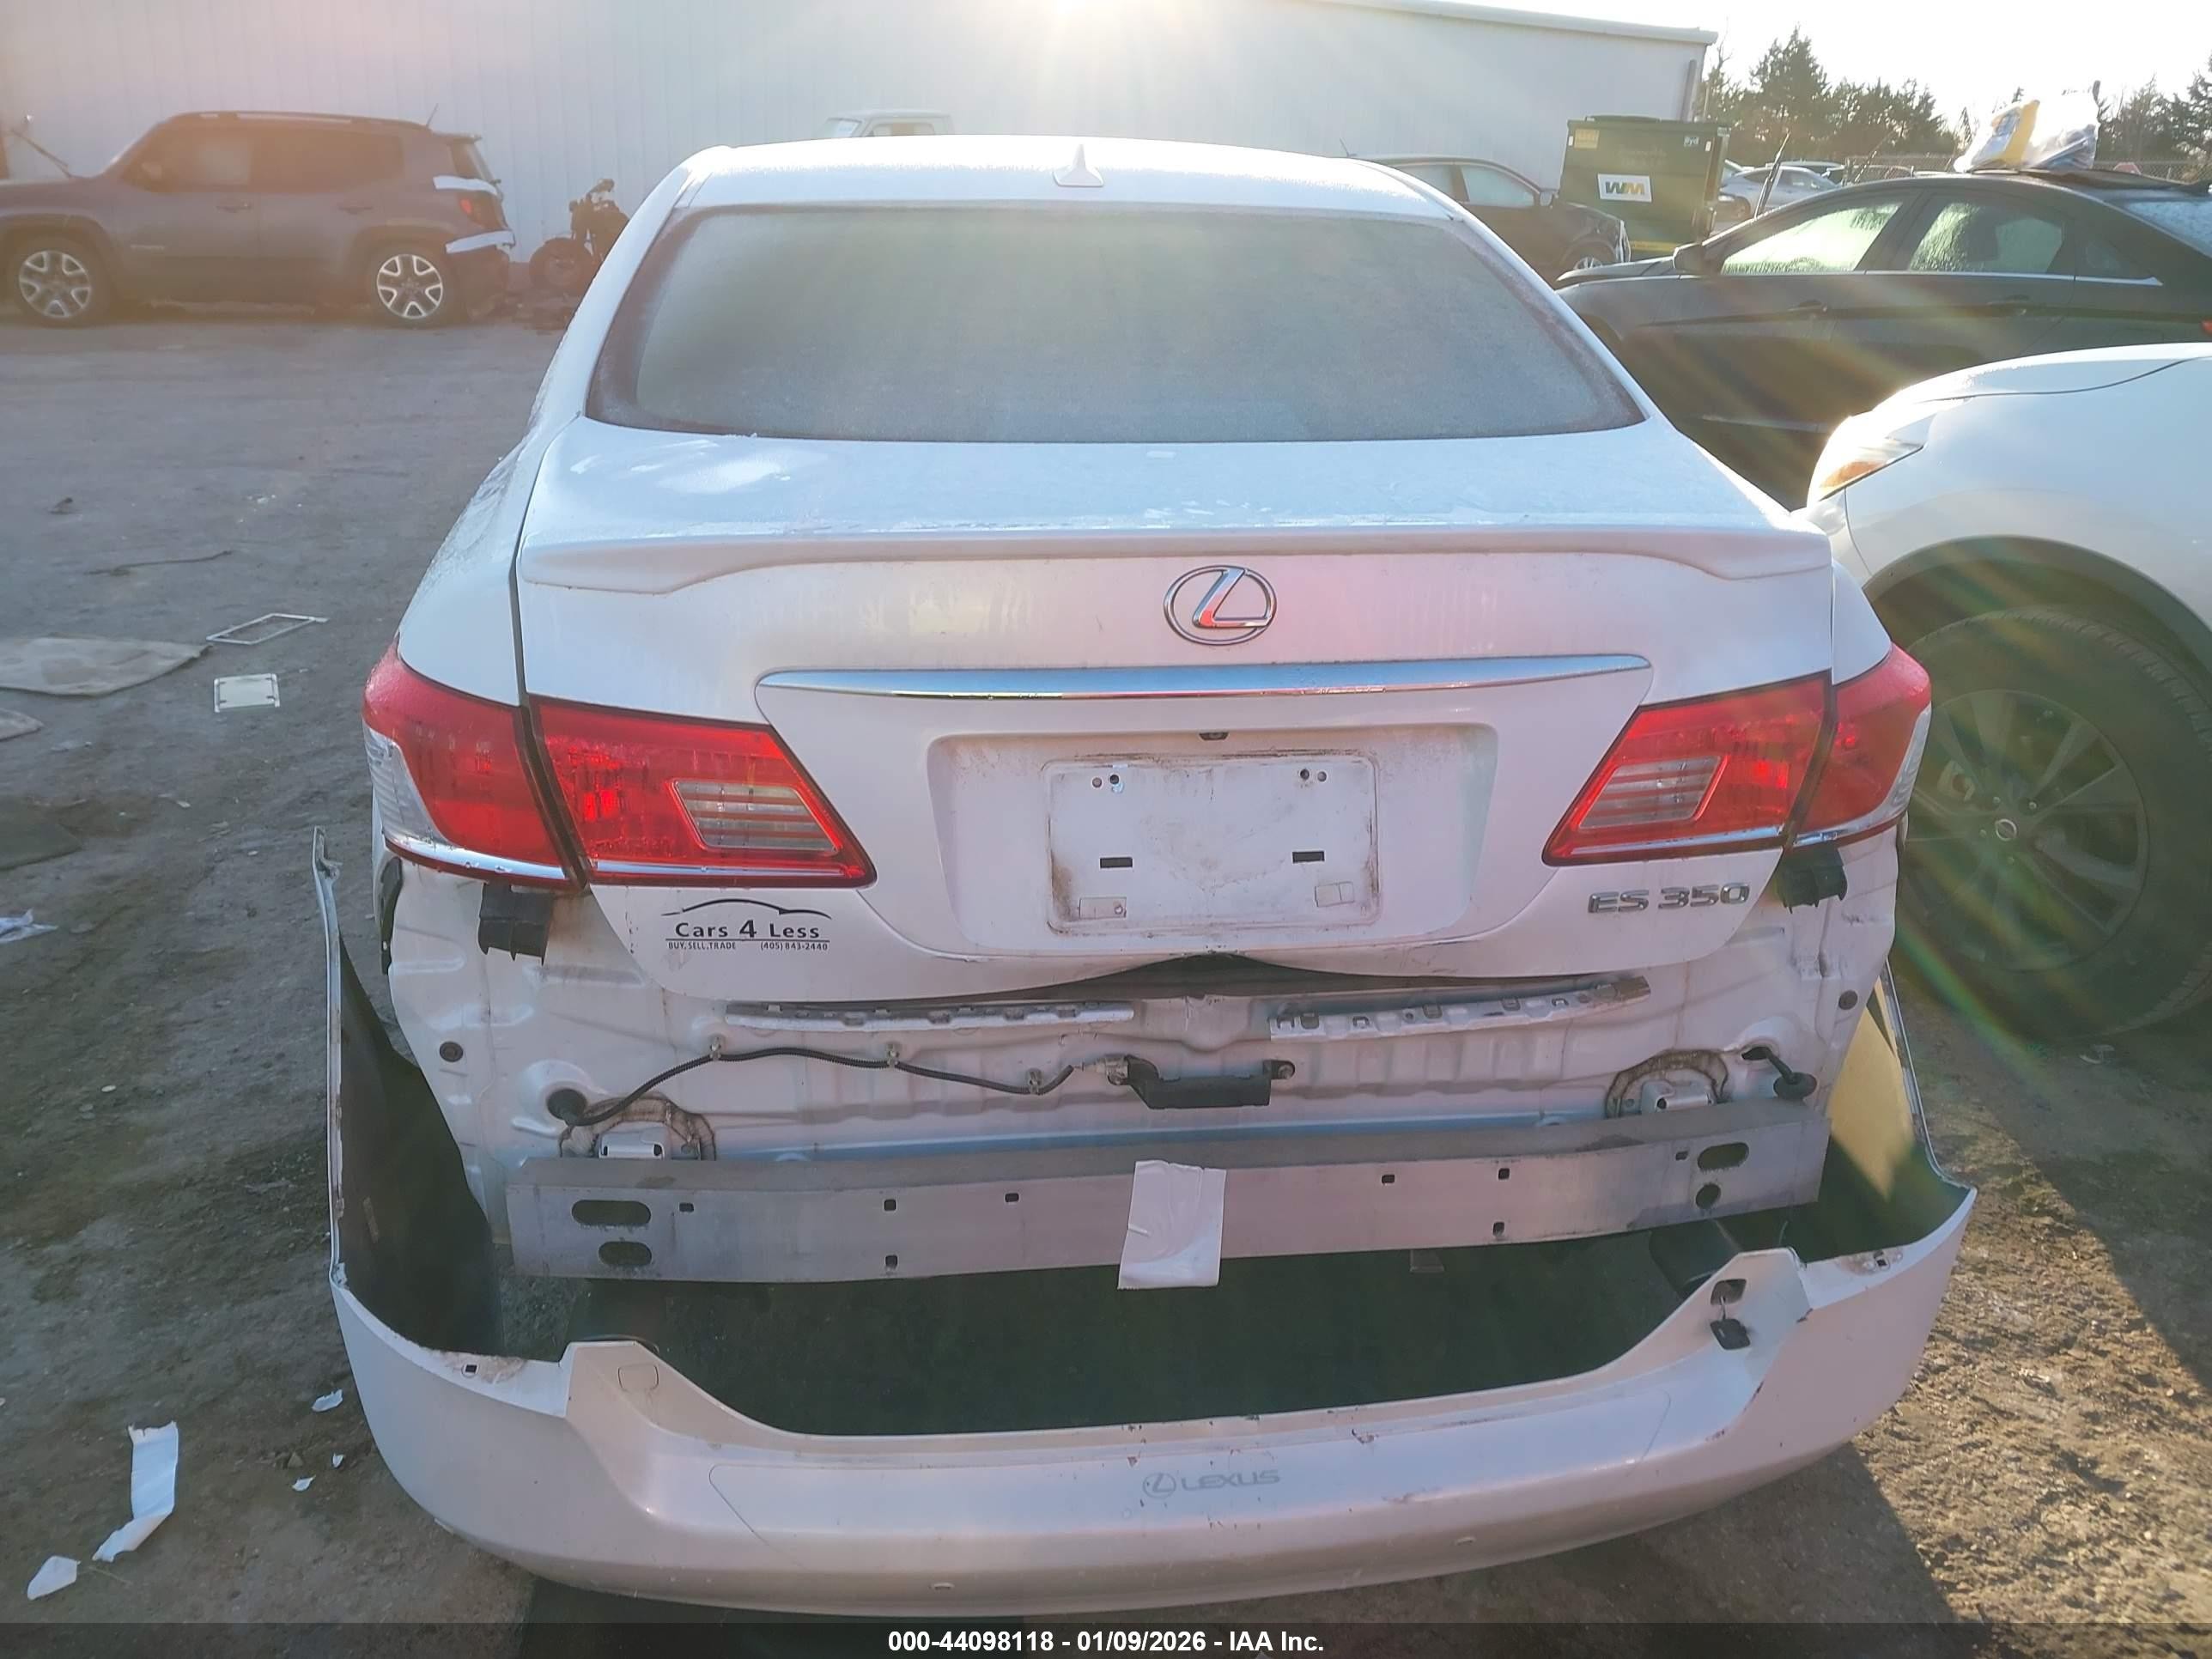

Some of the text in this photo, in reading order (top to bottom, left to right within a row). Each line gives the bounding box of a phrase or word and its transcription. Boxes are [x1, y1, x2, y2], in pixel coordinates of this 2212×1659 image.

[1605, 181, 1644, 195] WM
[1589, 883, 1750, 913] ES 350
[675, 920, 819, 939] Cars 4 Less
[1182, 1469, 1280, 1492] LEXUS
